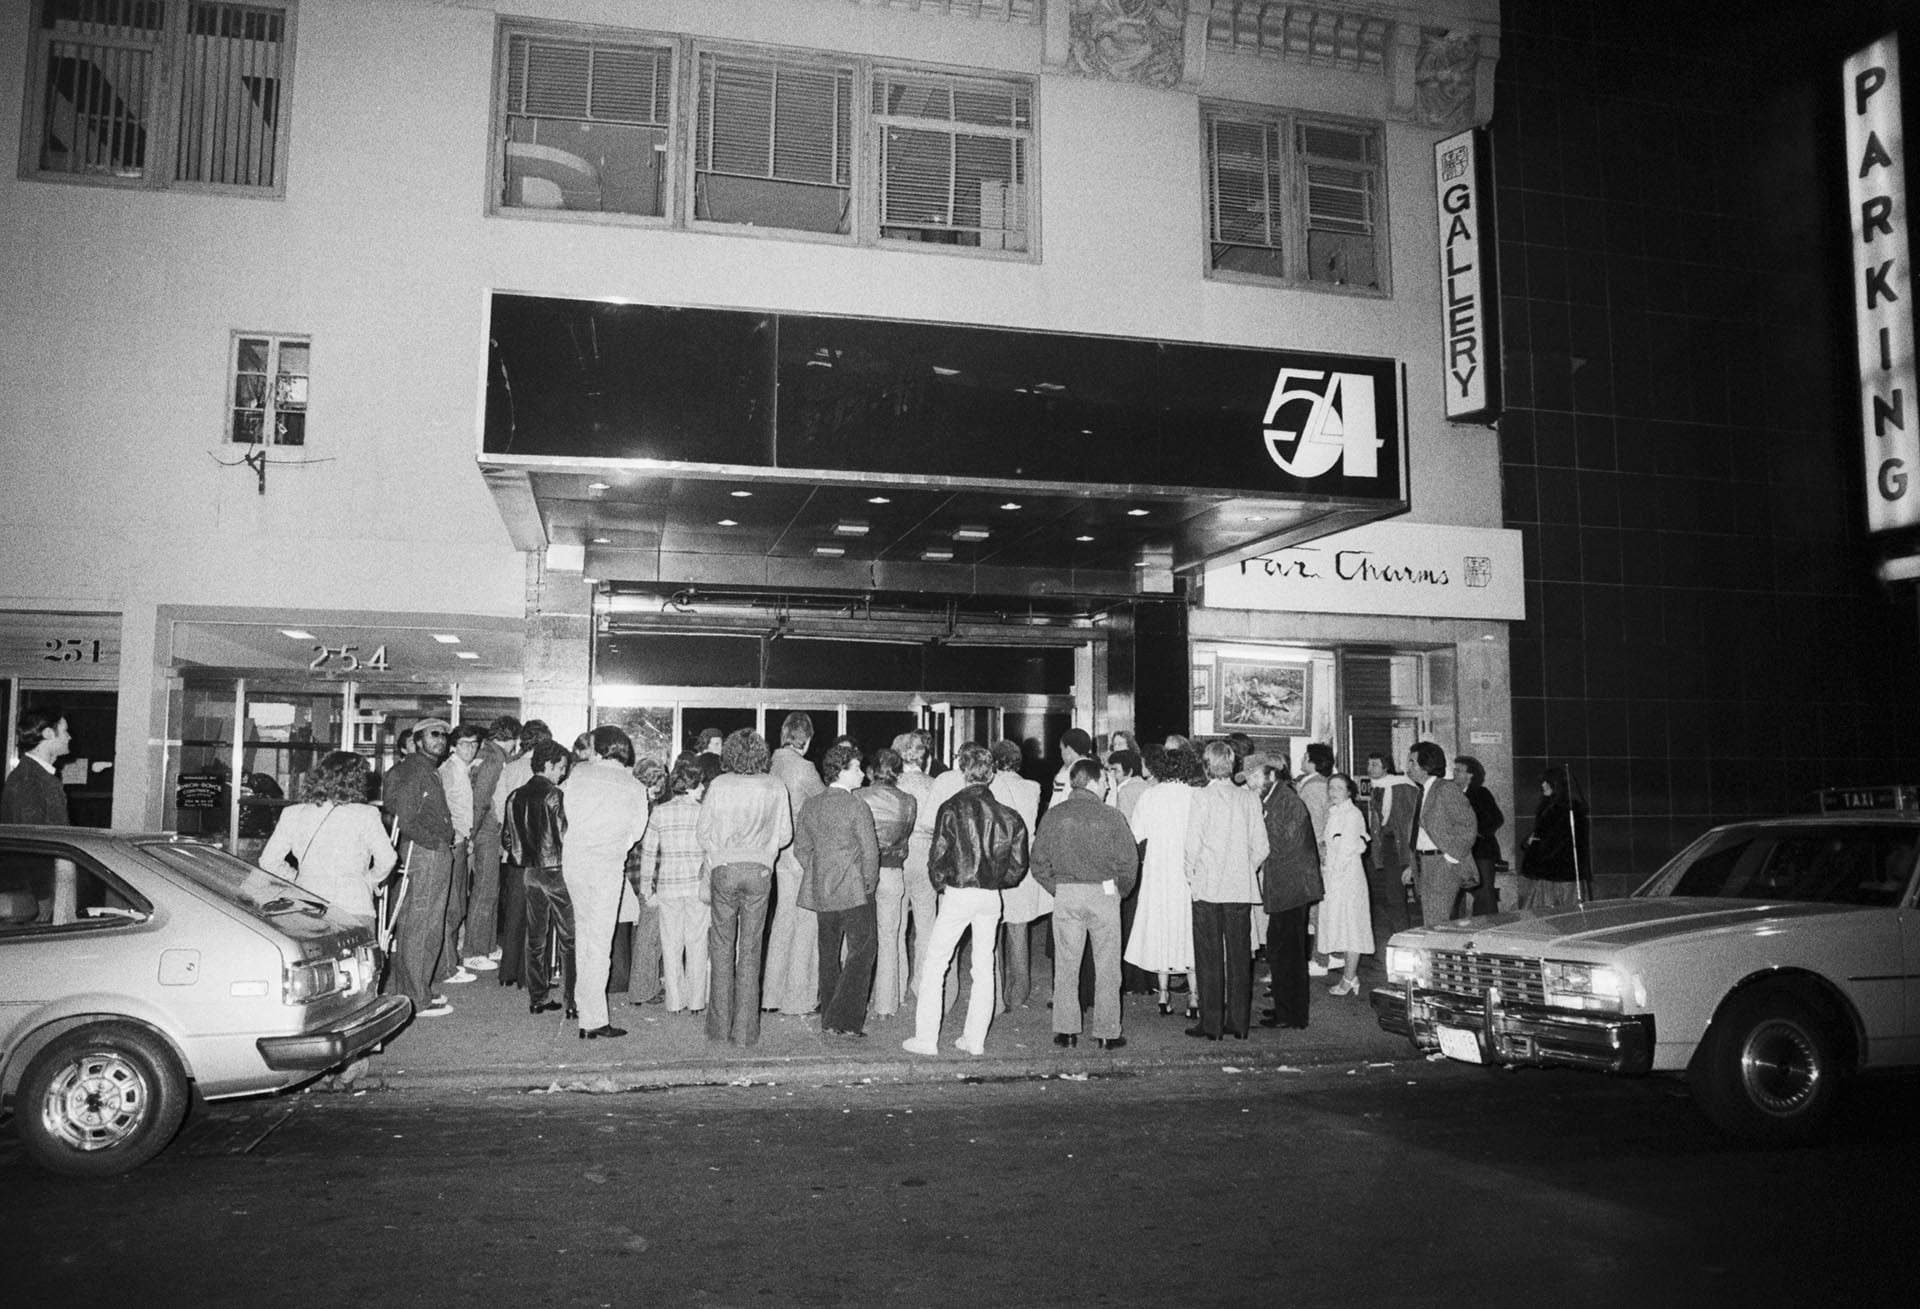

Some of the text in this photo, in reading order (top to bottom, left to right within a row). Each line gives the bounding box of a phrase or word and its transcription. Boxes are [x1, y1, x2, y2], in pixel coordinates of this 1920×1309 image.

[1443, 183, 1477, 398] GALLERY
[1855, 66, 1909, 502] PARKING
[1262, 367, 1385, 479] 54
[1335, 550, 1449, 585] Charms
[309, 644, 389, 673] 254
[1842, 791, 1875, 807] TAXI
